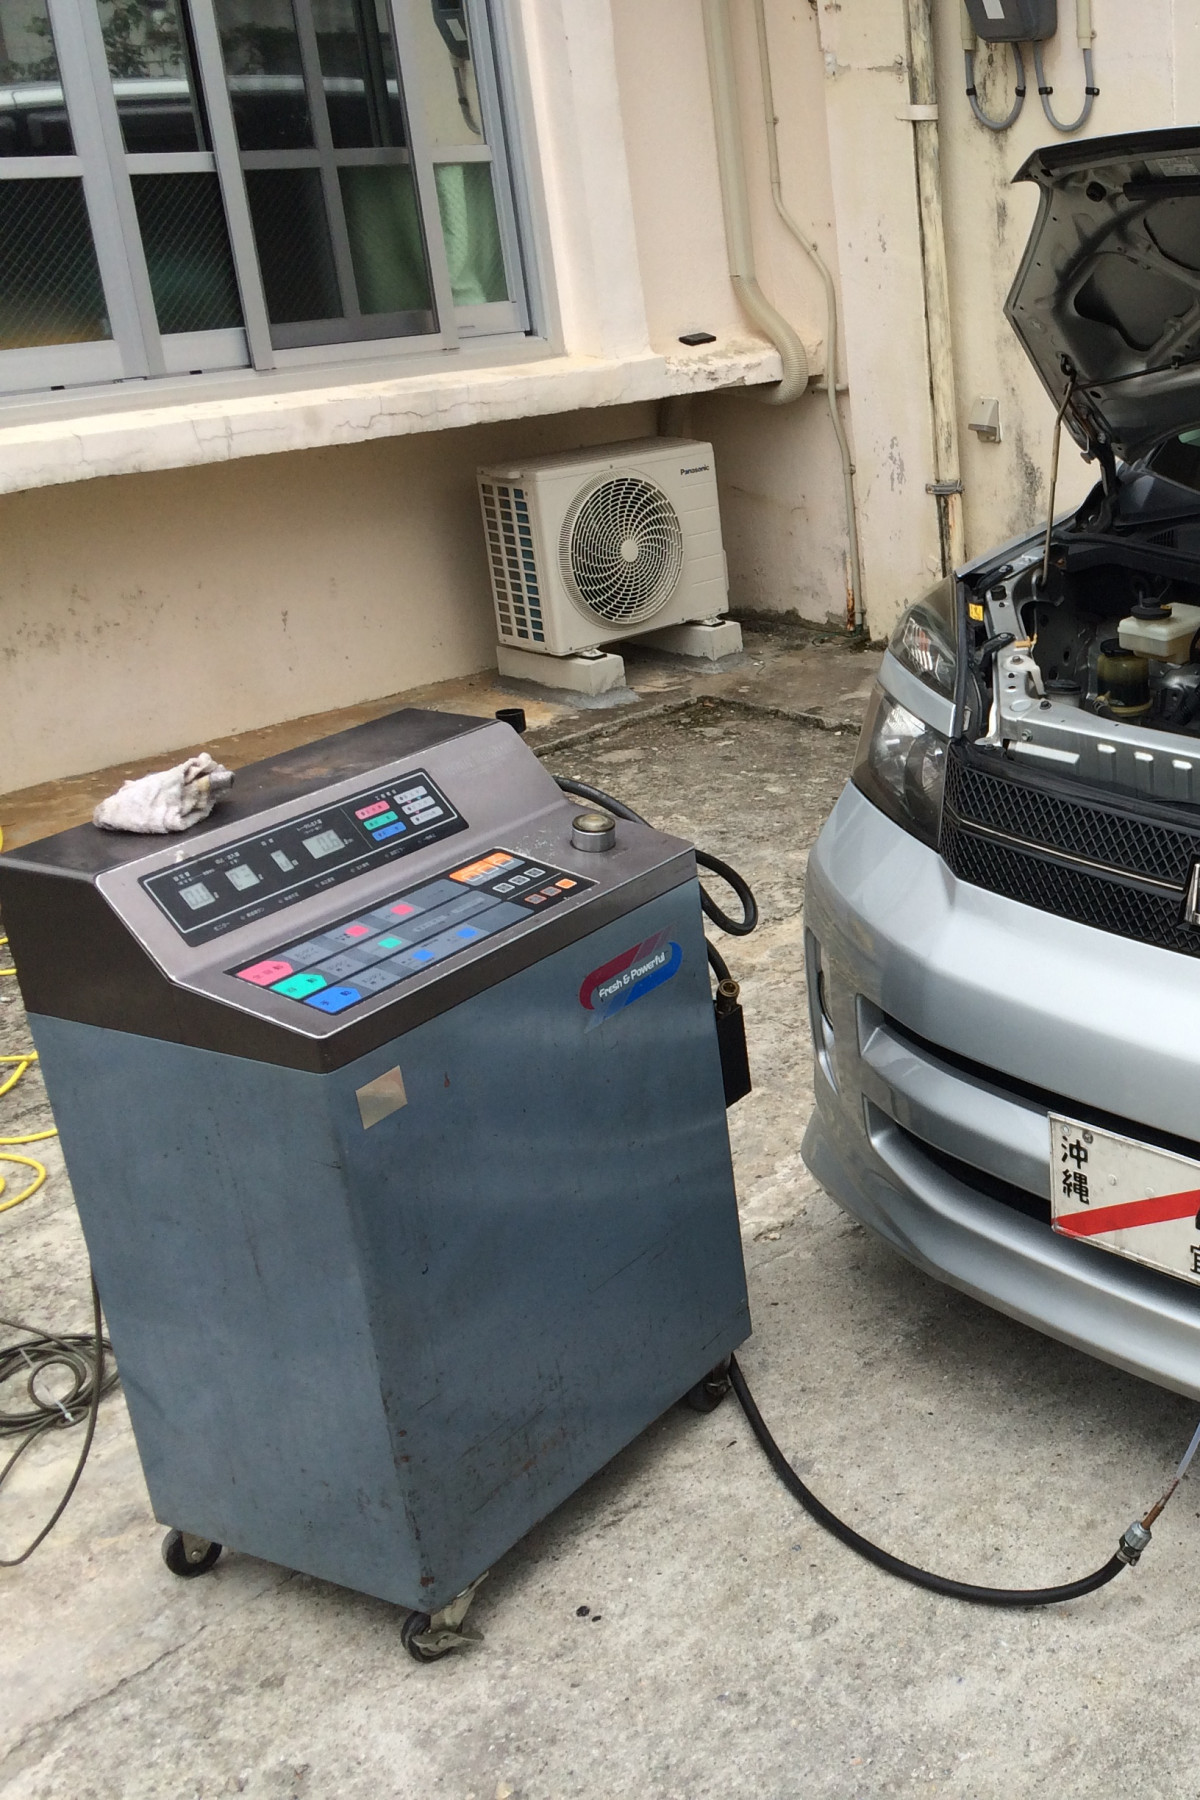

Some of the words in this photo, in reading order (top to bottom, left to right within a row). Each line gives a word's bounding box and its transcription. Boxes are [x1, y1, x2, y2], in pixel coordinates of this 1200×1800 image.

[680, 464, 709, 475] Panasonic
[599, 980, 623, 998] Fresh
[622, 975, 630, 985] &
[630, 952, 665, 980] Powerful
[1061, 1135, 1090, 1206] 沖縄
